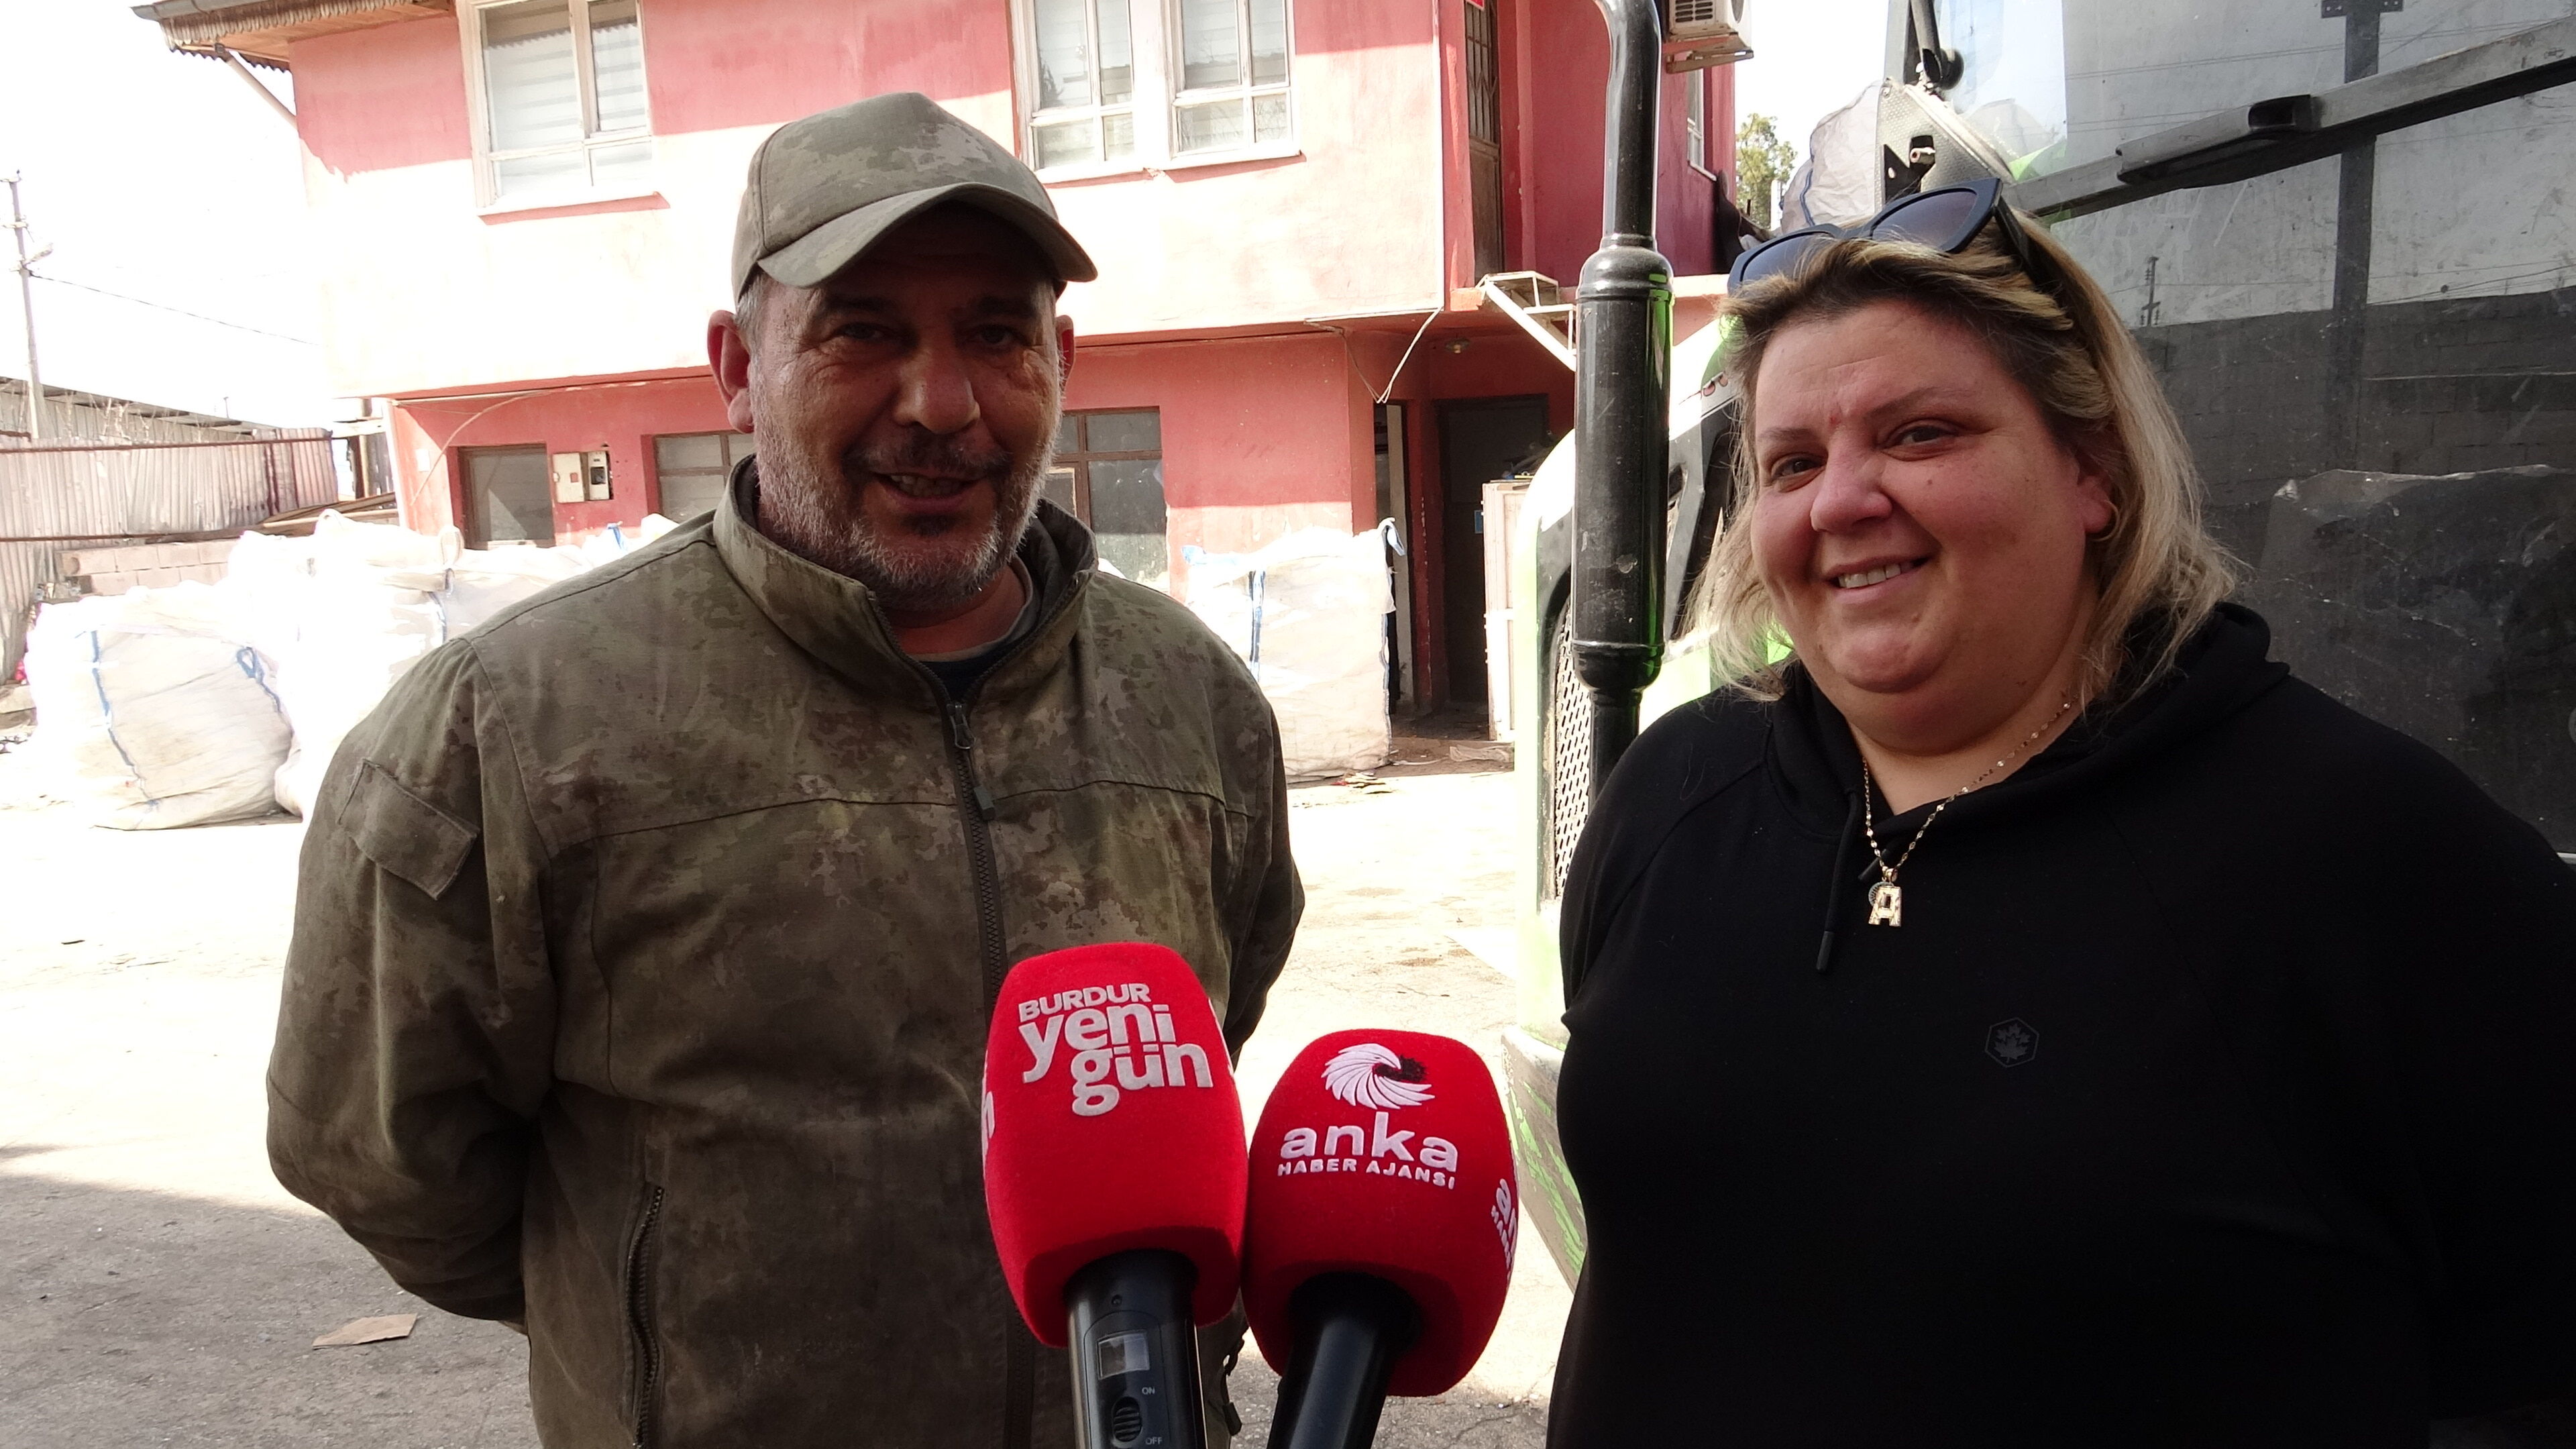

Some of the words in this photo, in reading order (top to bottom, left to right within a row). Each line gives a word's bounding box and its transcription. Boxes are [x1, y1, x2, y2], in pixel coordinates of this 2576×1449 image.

[1868, 885, 1902, 928] A
[1018, 983, 1151, 1023] BURDUR
[1018, 1004, 1176, 1084] yeni
[1071, 1043, 1214, 1116] gün
[1280, 1111, 1458, 1173] anka
[1277, 1158, 1357, 1177] HABER
[1366, 1160, 1455, 1190] AJANSI
[1141, 1387, 1156, 1395] ON
[1144, 1437, 1163, 1446] OFF
